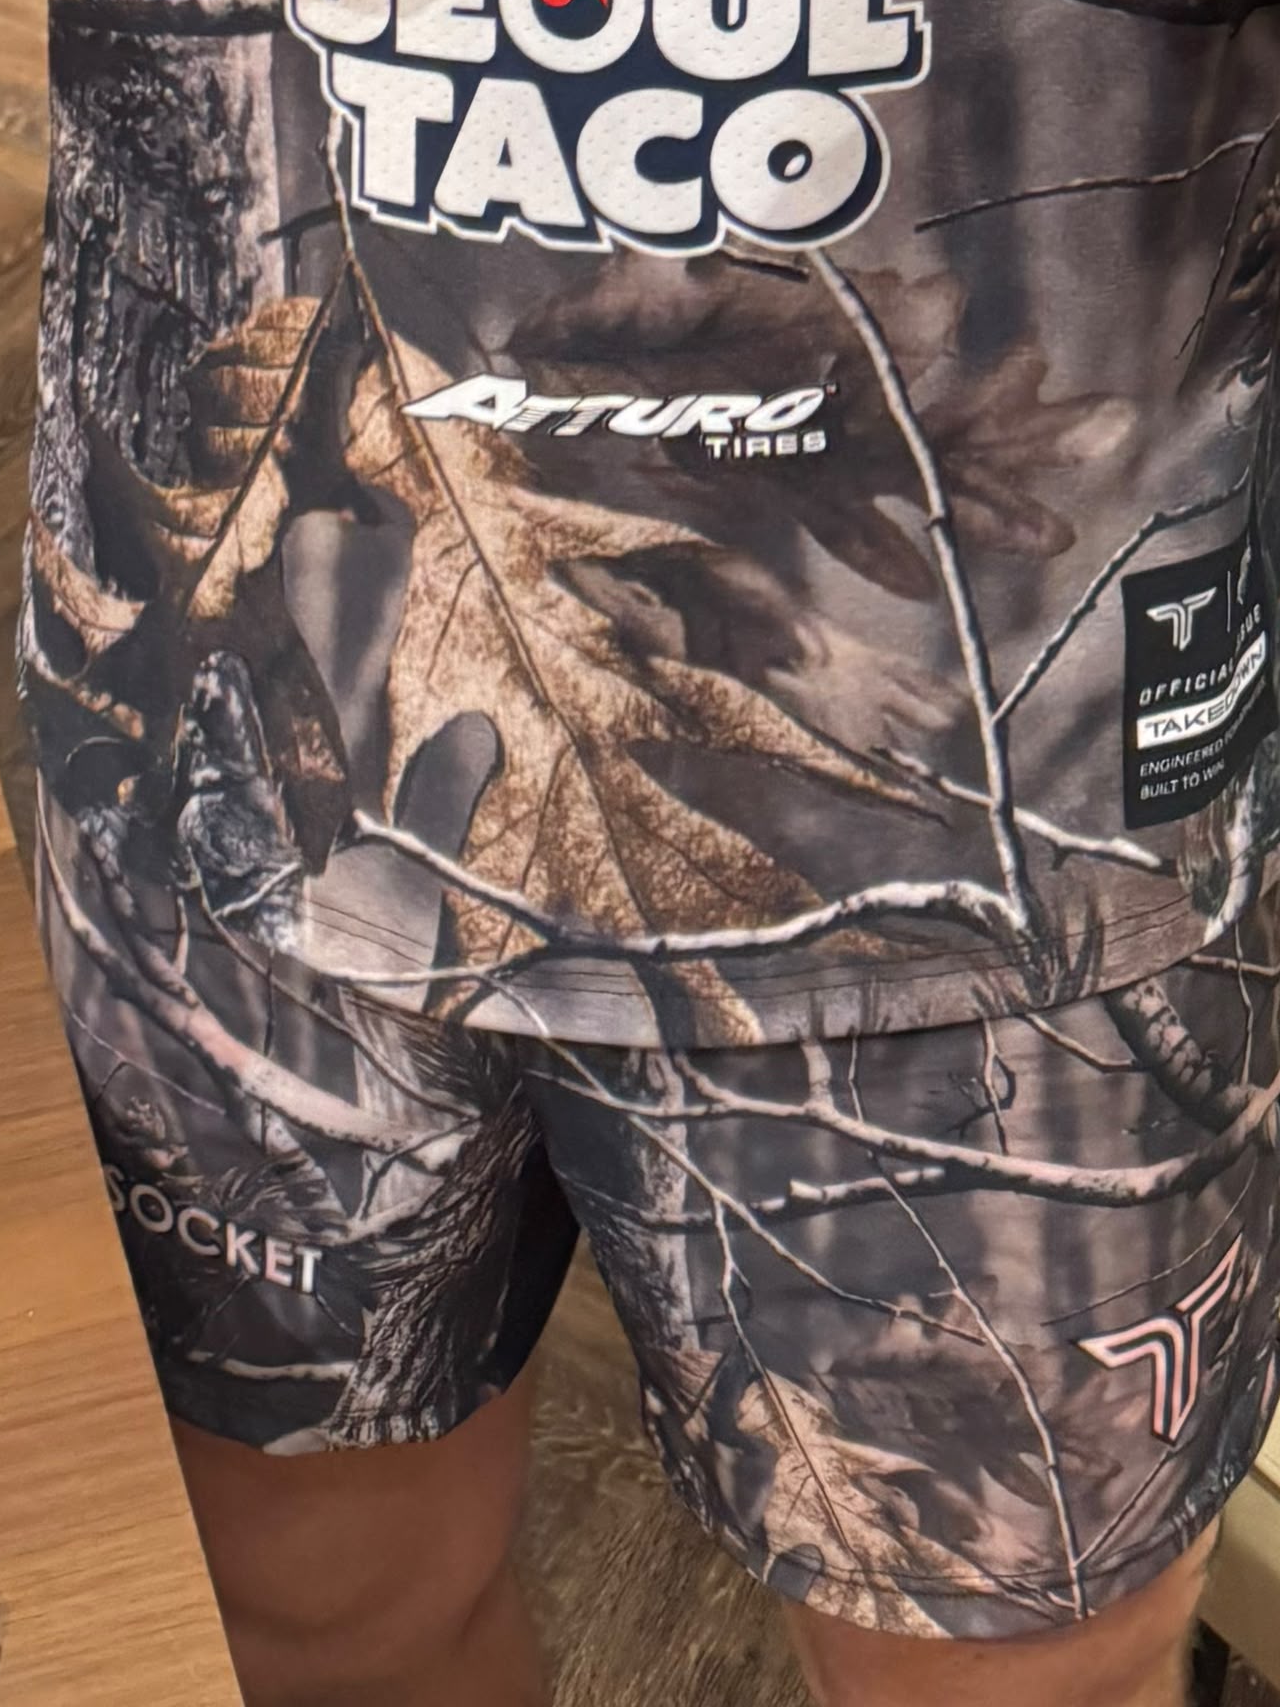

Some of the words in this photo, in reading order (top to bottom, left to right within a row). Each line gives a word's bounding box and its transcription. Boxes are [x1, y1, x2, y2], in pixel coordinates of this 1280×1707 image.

[330, 51, 869, 235] TACO
[401, 372, 826, 437] ATTURO
[705, 430, 827, 459] TIRES
[1144, 642, 1263, 739] TAKEDOWN
[1139, 738, 1228, 777] ENGINEERED
[1139, 779, 1179, 800] BUILT
[1182, 772, 1200, 788] TO
[102, 1163, 323, 1294] SOCKET
